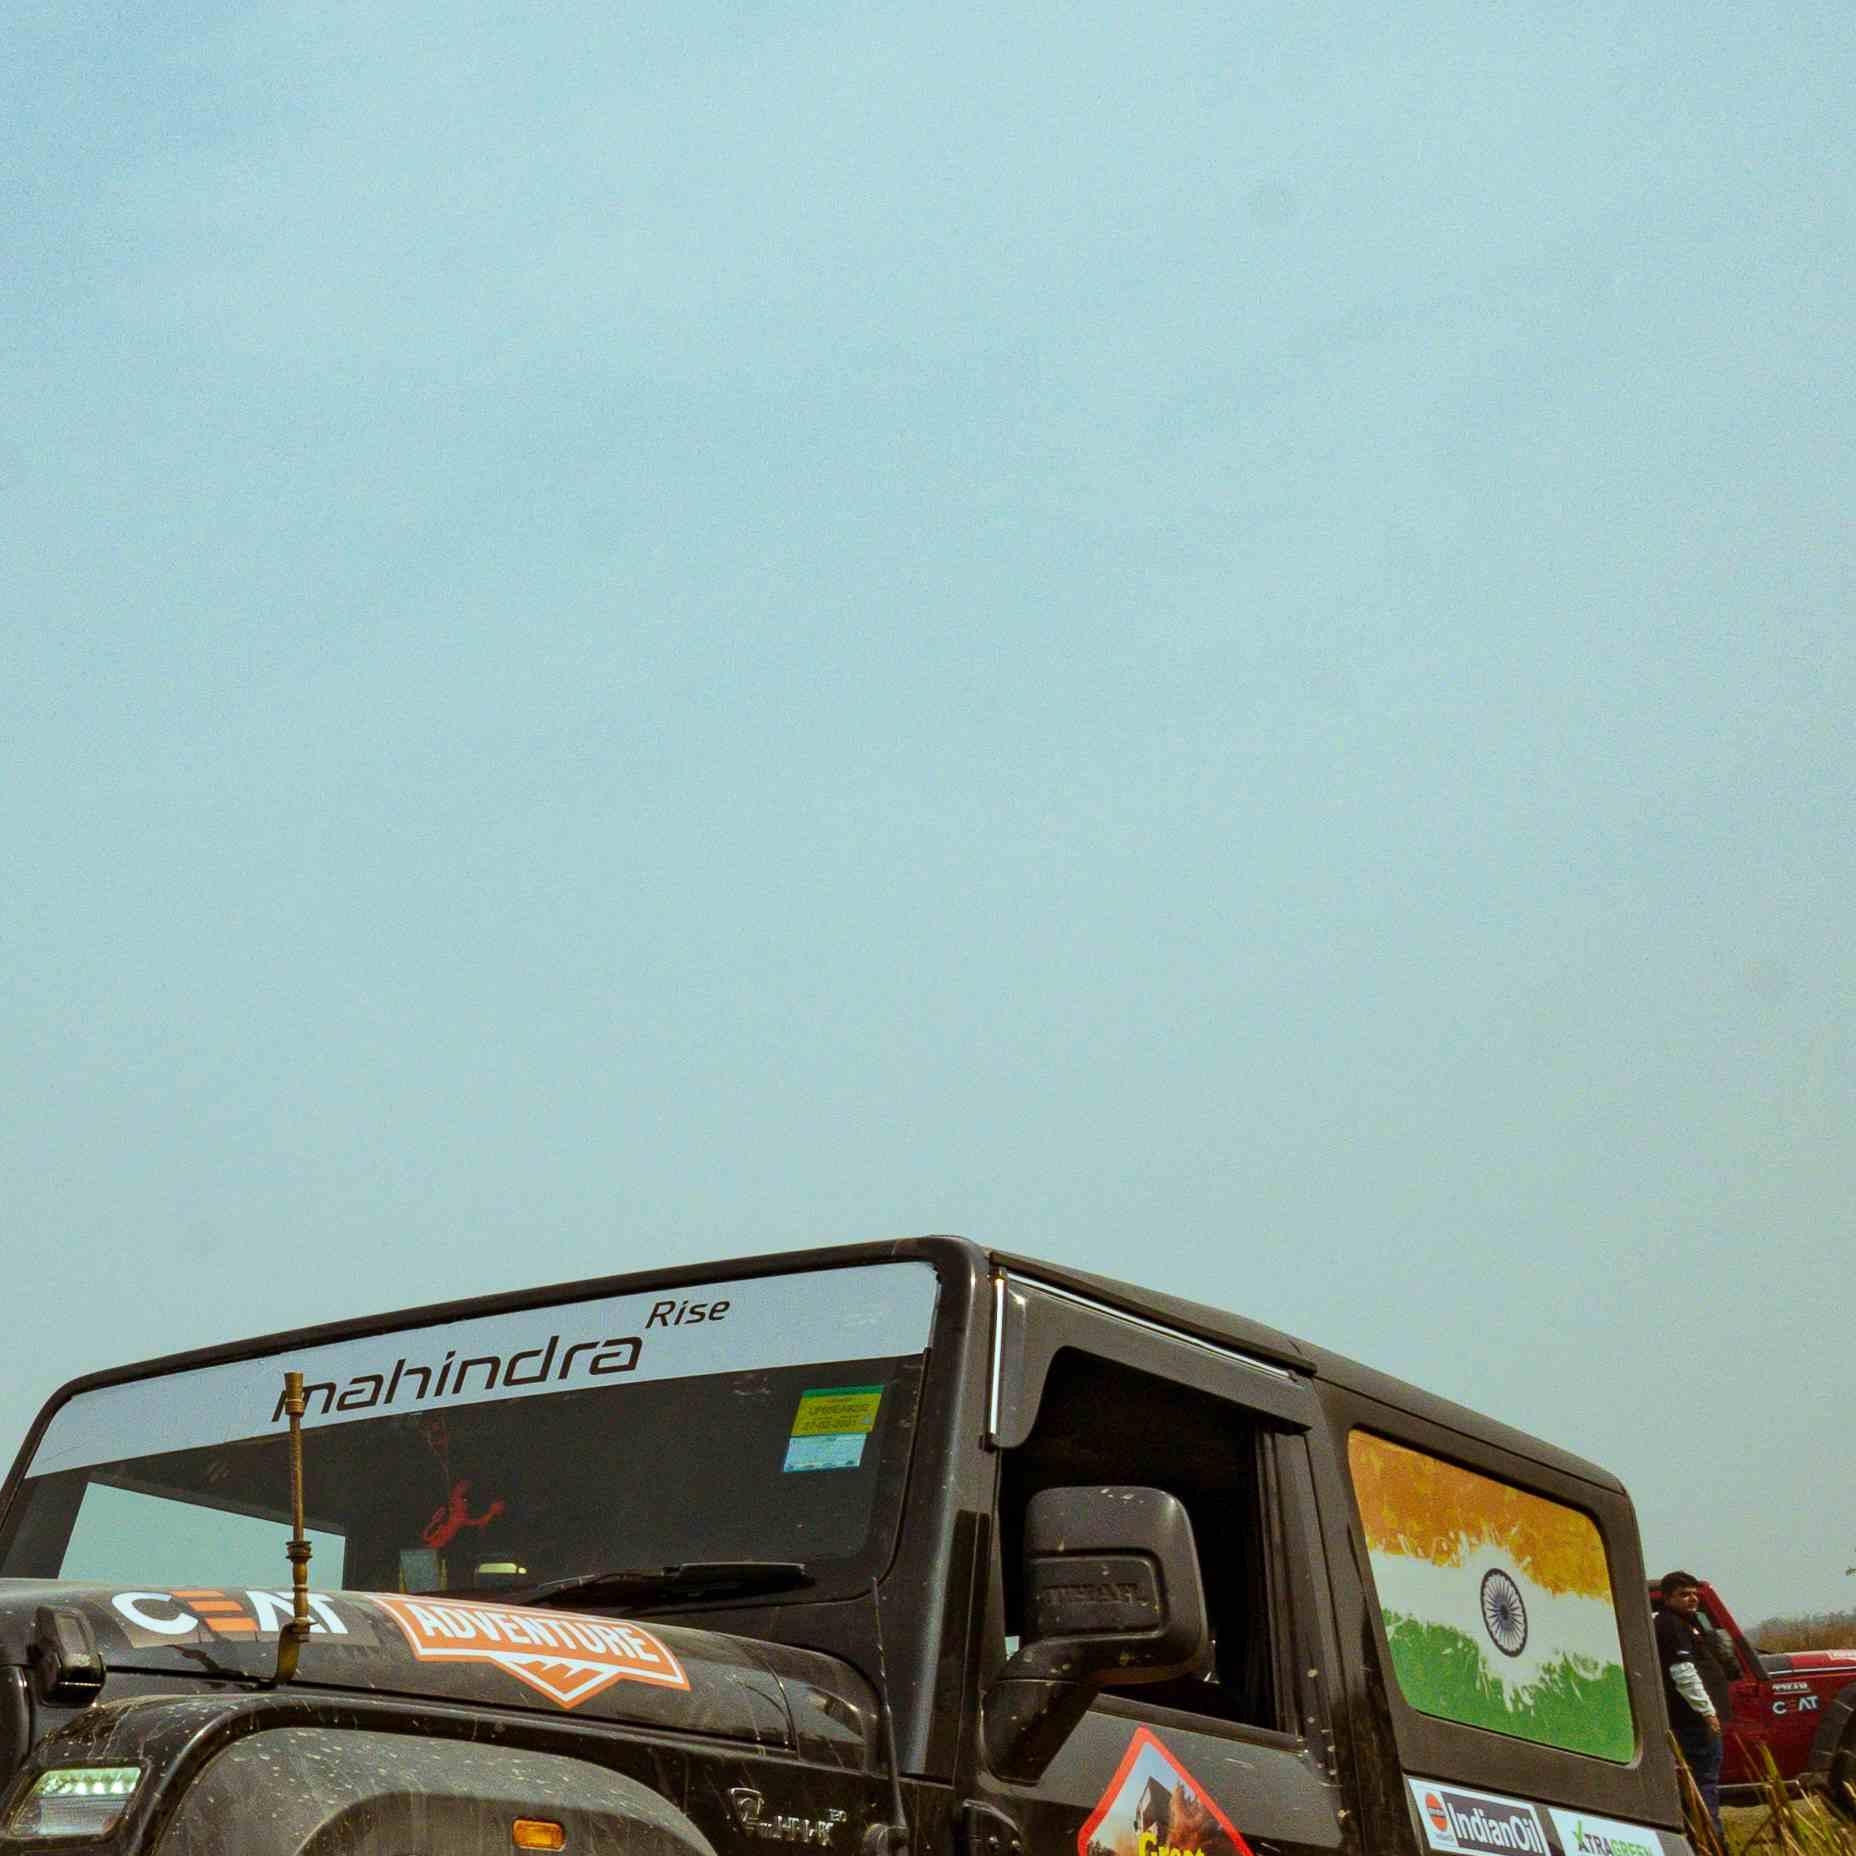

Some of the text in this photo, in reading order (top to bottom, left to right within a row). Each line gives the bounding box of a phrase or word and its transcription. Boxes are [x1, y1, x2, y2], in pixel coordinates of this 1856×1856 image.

[271, 1300, 731, 1422] mahindra Rise
[404, 1602, 661, 1663] ADVENTURE
[1446, 1802, 1544, 1855] IndianOil
